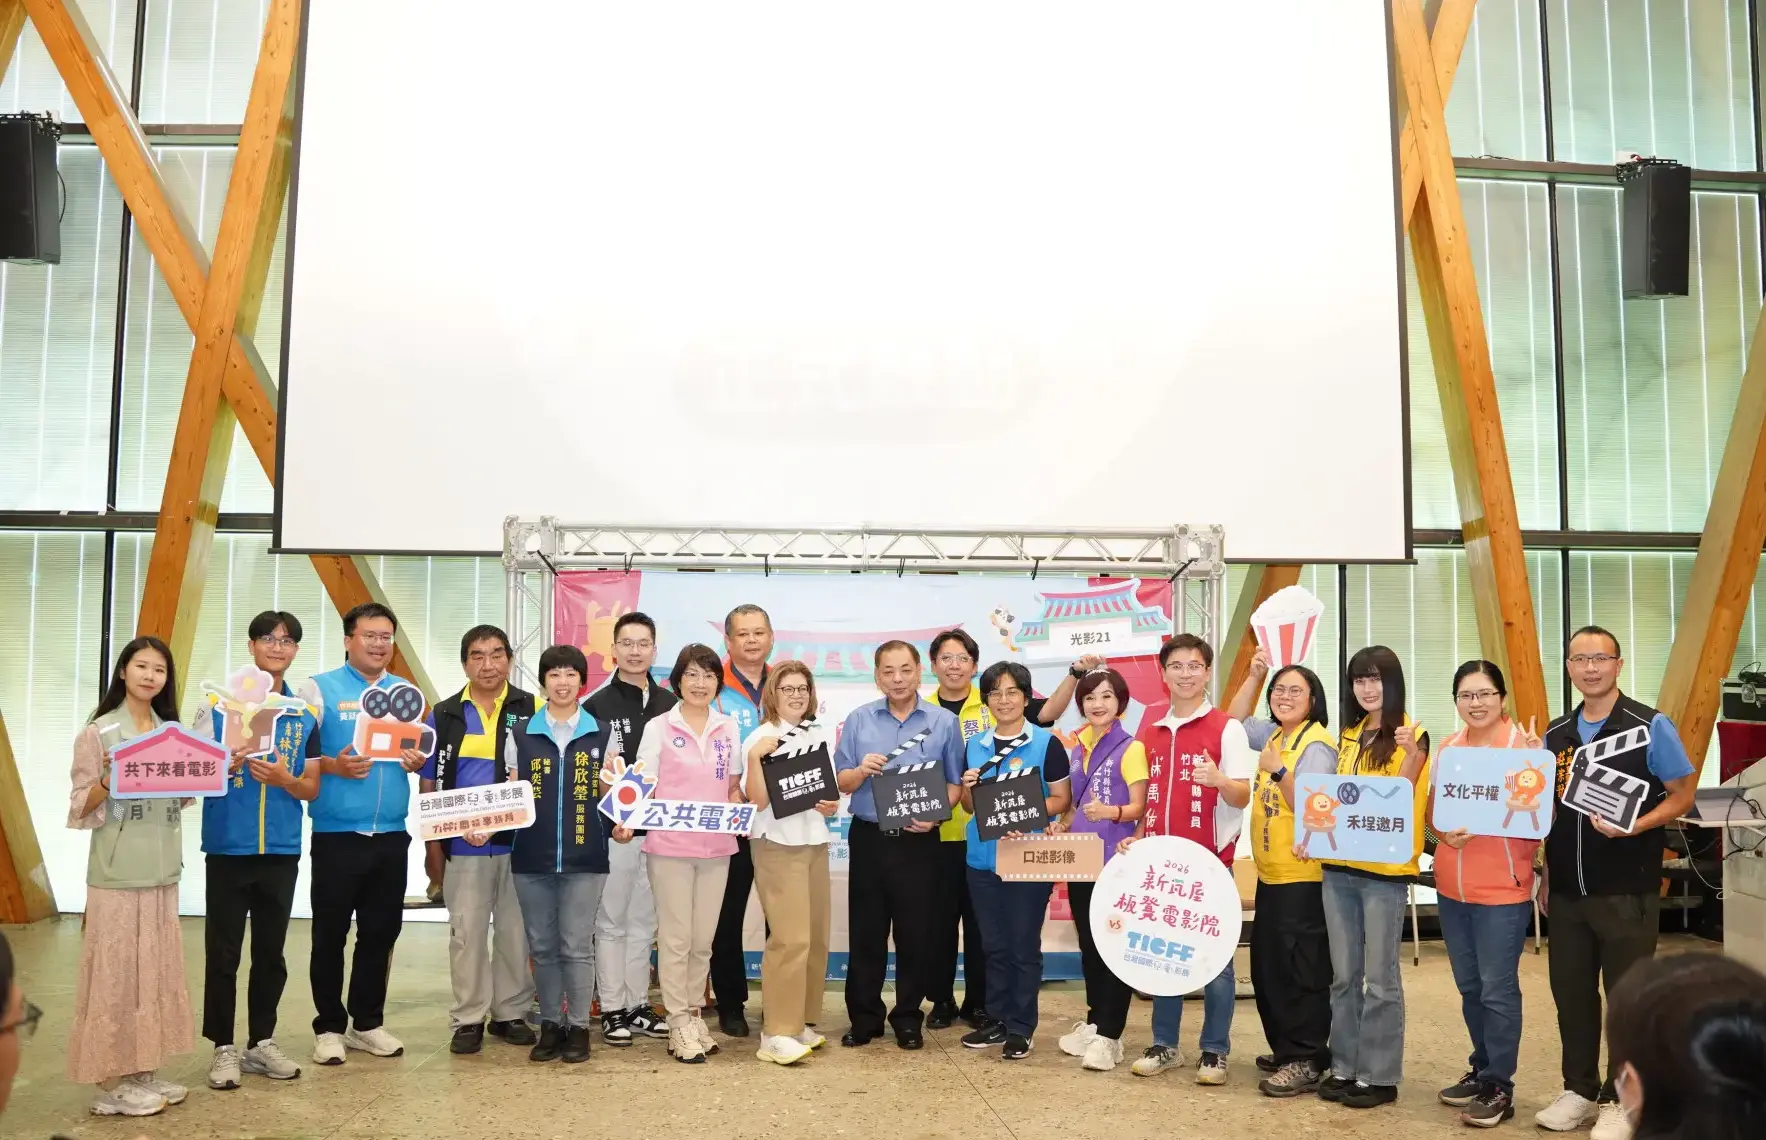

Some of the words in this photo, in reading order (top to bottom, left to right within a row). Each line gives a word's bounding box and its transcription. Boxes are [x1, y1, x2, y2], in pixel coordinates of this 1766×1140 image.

[1070, 632, 1111, 646] 光影21
[124, 761, 216, 778] 共下來看電影
[1190, 754, 1204, 829] 新縣議員
[1443, 782, 1500, 801] 文化平權
[641, 802, 753, 831] 公共電視
[1347, 815, 1405, 833] 禾埕邀月
[1023, 850, 1075, 864] 口述影像
[1164, 860, 1190, 874] 2026
[1140, 865, 1205, 902] 新瓦屋
[1113, 893, 1221, 937] 板凳電影院
[1127, 931, 1195, 962] TICFF
